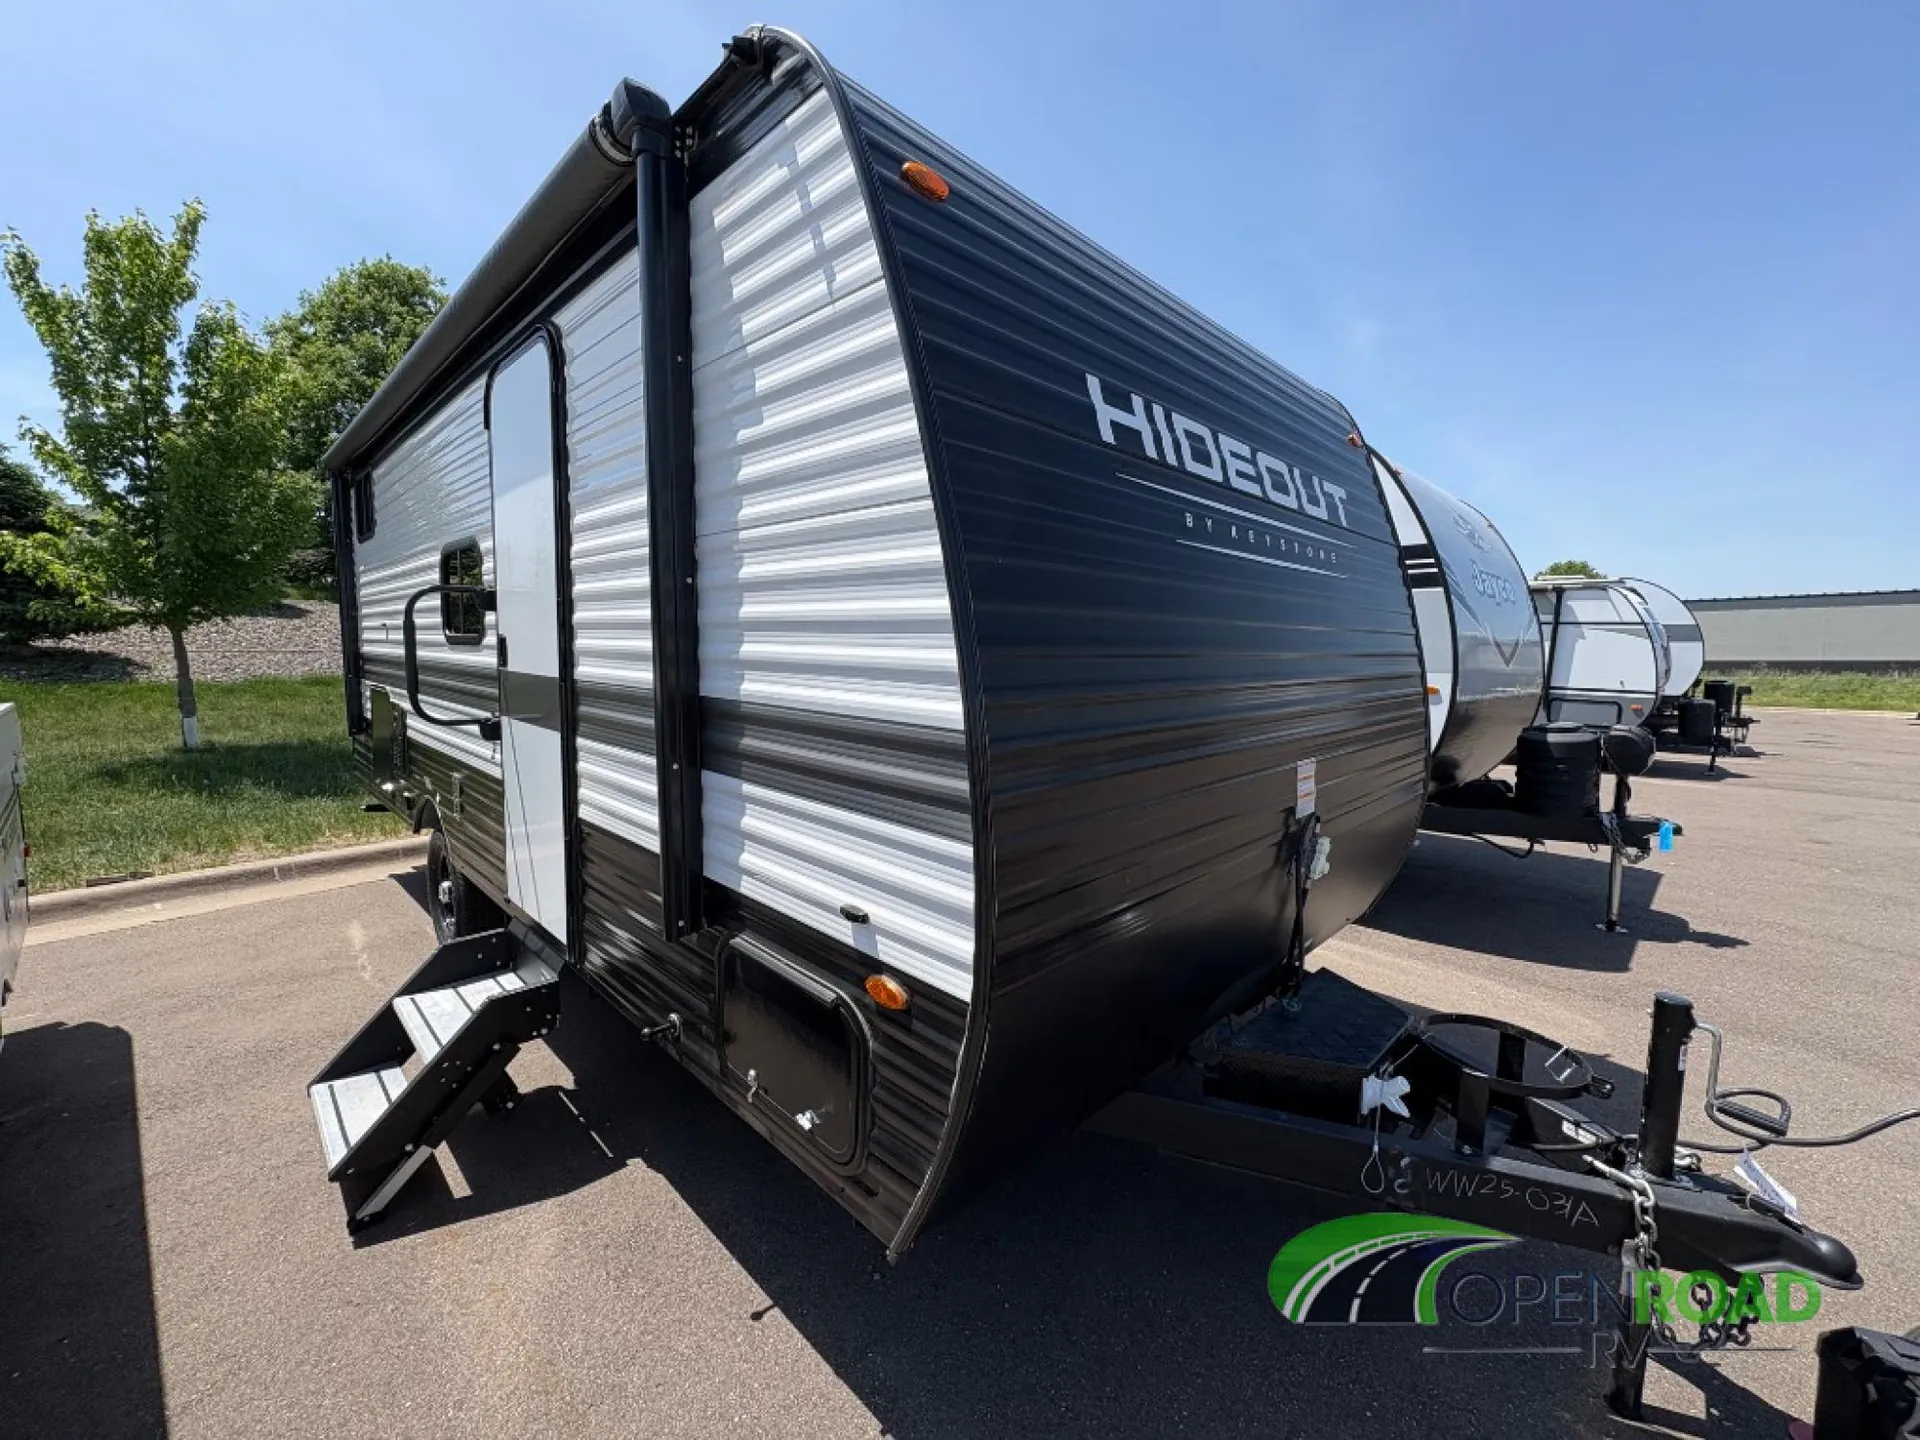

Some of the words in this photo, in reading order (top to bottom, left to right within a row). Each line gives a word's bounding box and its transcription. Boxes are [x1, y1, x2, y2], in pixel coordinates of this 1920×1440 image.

[1085, 373, 1348, 527] HIDEOUT
[1184, 511, 1213, 534] BY
[1230, 525, 1338, 564] KEYSTONE
